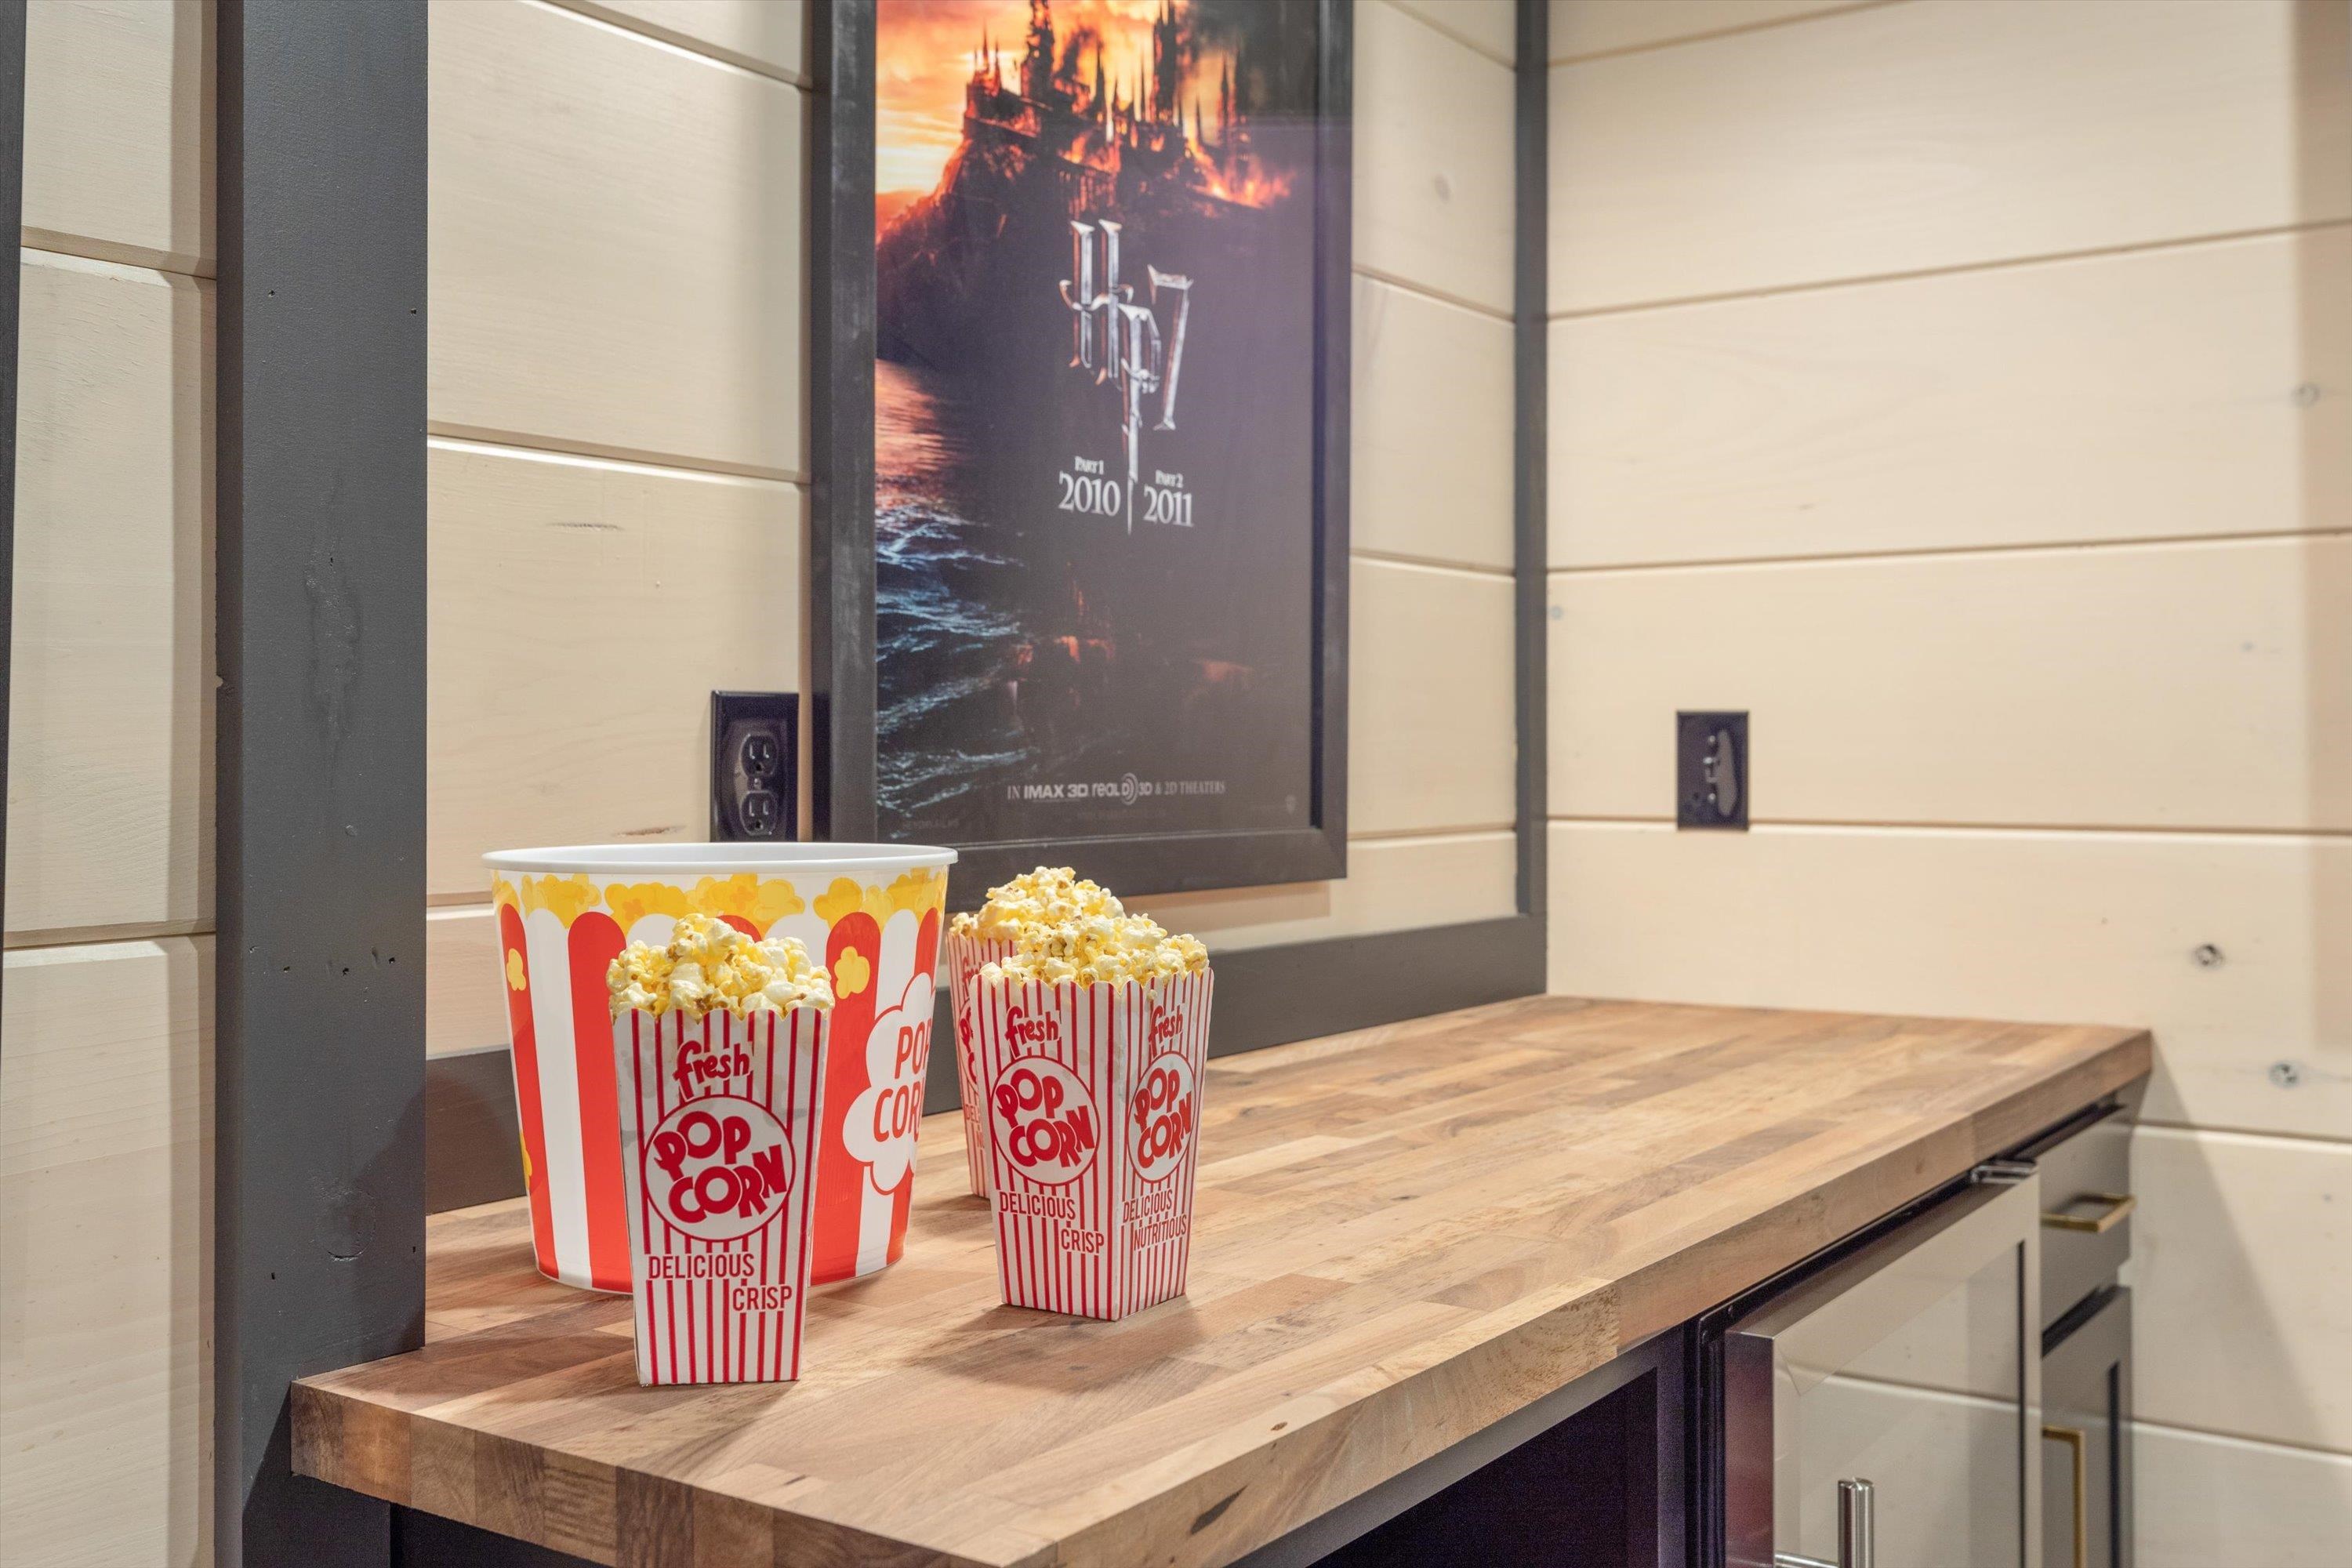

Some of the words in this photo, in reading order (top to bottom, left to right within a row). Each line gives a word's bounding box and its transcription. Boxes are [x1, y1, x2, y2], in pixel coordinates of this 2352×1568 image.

[1058, 470, 1121, 517] 2010
[1143, 484, 1194, 528] 2011
[1007, 785, 1021, 800] IN
[1023, 784, 1065, 799] IMAX
[1067, 783, 1089, 798] 3D
[1138, 782, 1153, 797] 3D
[1005, 1006, 1058, 1058] fresh
[1149, 1005, 1183, 1058] fresh
[673, 1040, 750, 1099] fresh
[996, 1068, 1064, 1130] POP
[1135, 1068, 1180, 1131] POP
[654, 1111, 751, 1181] POP
[1008, 1105, 1095, 1169] CORN
[1137, 1091, 1192, 1169] CORN
[668, 1144, 787, 1223] CORN
[999, 1192, 1076, 1220] DELICIOUS
[1123, 1189, 1172, 1223] DELICIOUS
[1061, 1227, 1105, 1253] CRISP
[1134, 1214, 1187, 1250] NUTRITIOUS
[648, 1254, 754, 1279] DELICIOUS
[733, 1283, 793, 1312] CRISP
